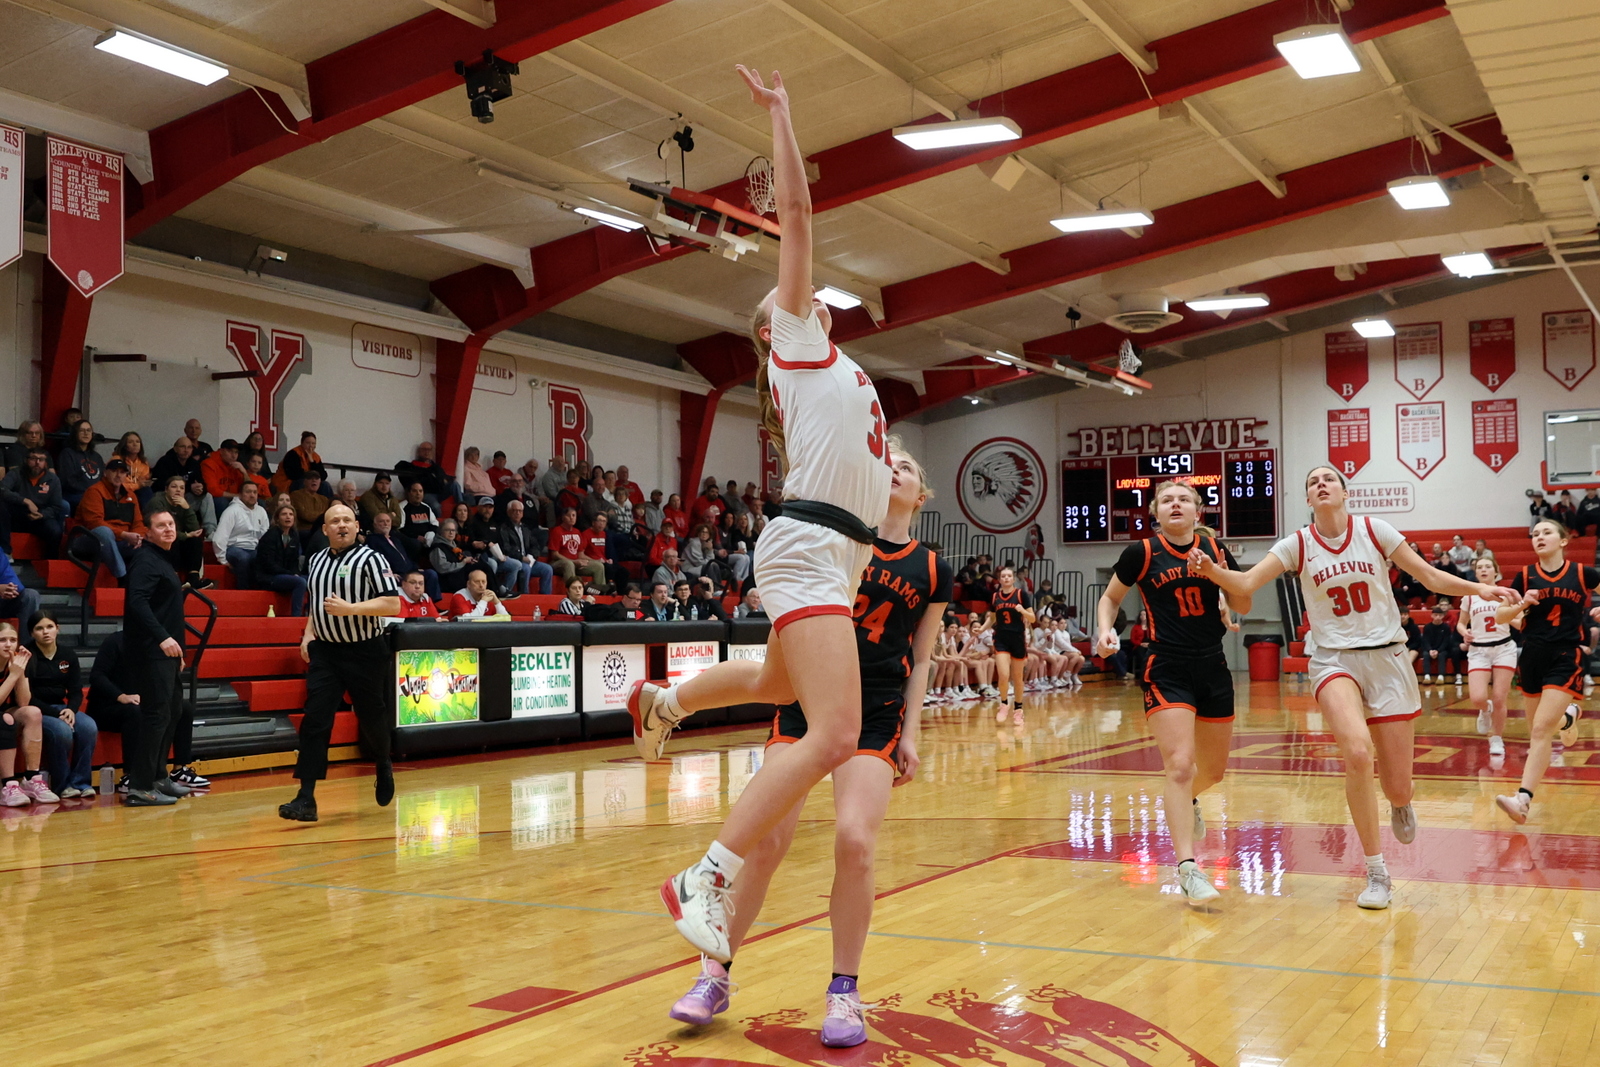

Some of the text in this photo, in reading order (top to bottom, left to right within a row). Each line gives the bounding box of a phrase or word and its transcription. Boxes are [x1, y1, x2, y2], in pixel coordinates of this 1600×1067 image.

[4, 130, 18, 148] HS
[50, 141, 119, 173] BELLEVUE HS
[81, 170, 98, 181] PLACE
[101, 170, 121, 180] TEAMS
[67, 182, 85, 191] STATE
[88, 185, 110, 197] CHAMPS
[81, 178, 98, 188] PLACE
[67, 189, 85, 197] STATE
[88, 193, 110, 204] CHAMPS
[81, 198, 98, 207] PLACE
[82, 204, 98, 214] PLACE
[83, 211, 100, 220] PLACE
[362, 340, 412, 360] VISITORS
[476, 363, 507, 380] LEVUE
[1564, 368, 1576, 381] B
[226, 319, 304, 452] Y
[1413, 378, 1425, 392] B
[1487, 372, 1500, 387] B
[1342, 383, 1354, 396] B
[548, 383, 589, 472] R
[1079, 419, 1256, 457] BELLEVUE
[1151, 454, 1191, 474] 4:59
[1236, 460, 1272, 473] 3 0 0
[1343, 460, 1356, 474] B
[1416, 458, 1428, 470] B
[1489, 454, 1502, 468] B
[1235, 473, 1272, 484] 4 0 3
[1132, 490, 1142, 507] 7
[1207, 486, 1219, 505] 5
[1232, 486, 1272, 497] 10 0 0
[1349, 487, 1409, 498] BELLEVUE
[1349, 498, 1409, 508] STUDENTS
[1066, 505, 1106, 517] 30 0 0
[1066, 518, 1078, 529] 32
[1100, 517, 1106, 528] 5
[1136, 519, 1142, 530] 5
[1151, 566, 1184, 588] LADY
[1313, 561, 1375, 587] BELLEVUE
[878, 569, 920, 609] RAMS
[1539, 587, 1582, 604] DY RAMS
[1174, 586, 1205, 617] 10
[1327, 581, 1371, 617] 30
[421, 607, 428, 616] B
[1003, 611, 1011, 624] 3
[1547, 604, 1560, 626] 4
[1484, 616, 1497, 632] 2
[670, 646, 713, 658] LAUGHLIN
[511, 652, 572, 671] BECKLEY
[547, 674, 571, 688] HEATING
[513, 694, 568, 711] AIR CONDITIONING
